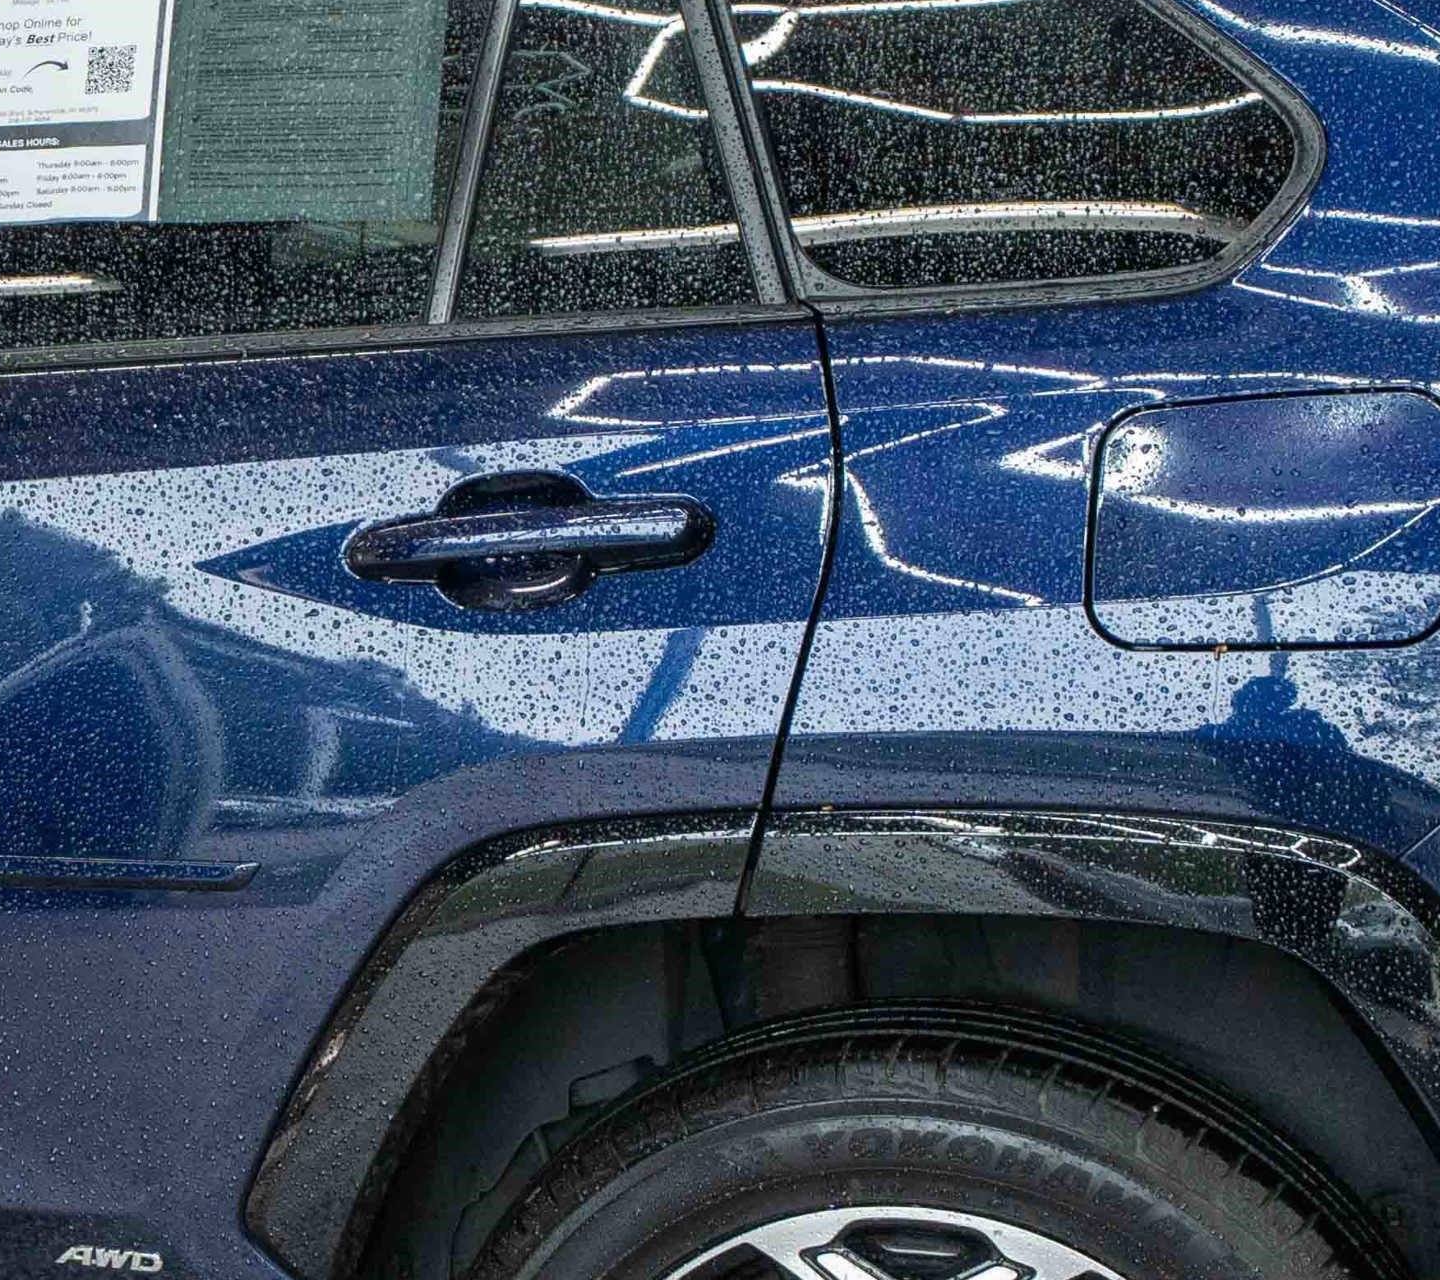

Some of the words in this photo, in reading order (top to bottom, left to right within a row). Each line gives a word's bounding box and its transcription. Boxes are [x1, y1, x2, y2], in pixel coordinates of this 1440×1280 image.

[23, 18, 62, 30] Online
[65, 16, 82, 27] for
[26, 34, 55, 45] Best
[57, 31, 92, 43] Price!
[26, 137, 61, 147] HOURS:
[37, 160, 71, 169] Thursday
[36, 186, 69, 195] Saturday
[26, 200, 52, 209] Closed
[53, 1246, 164, 1272] AWD
